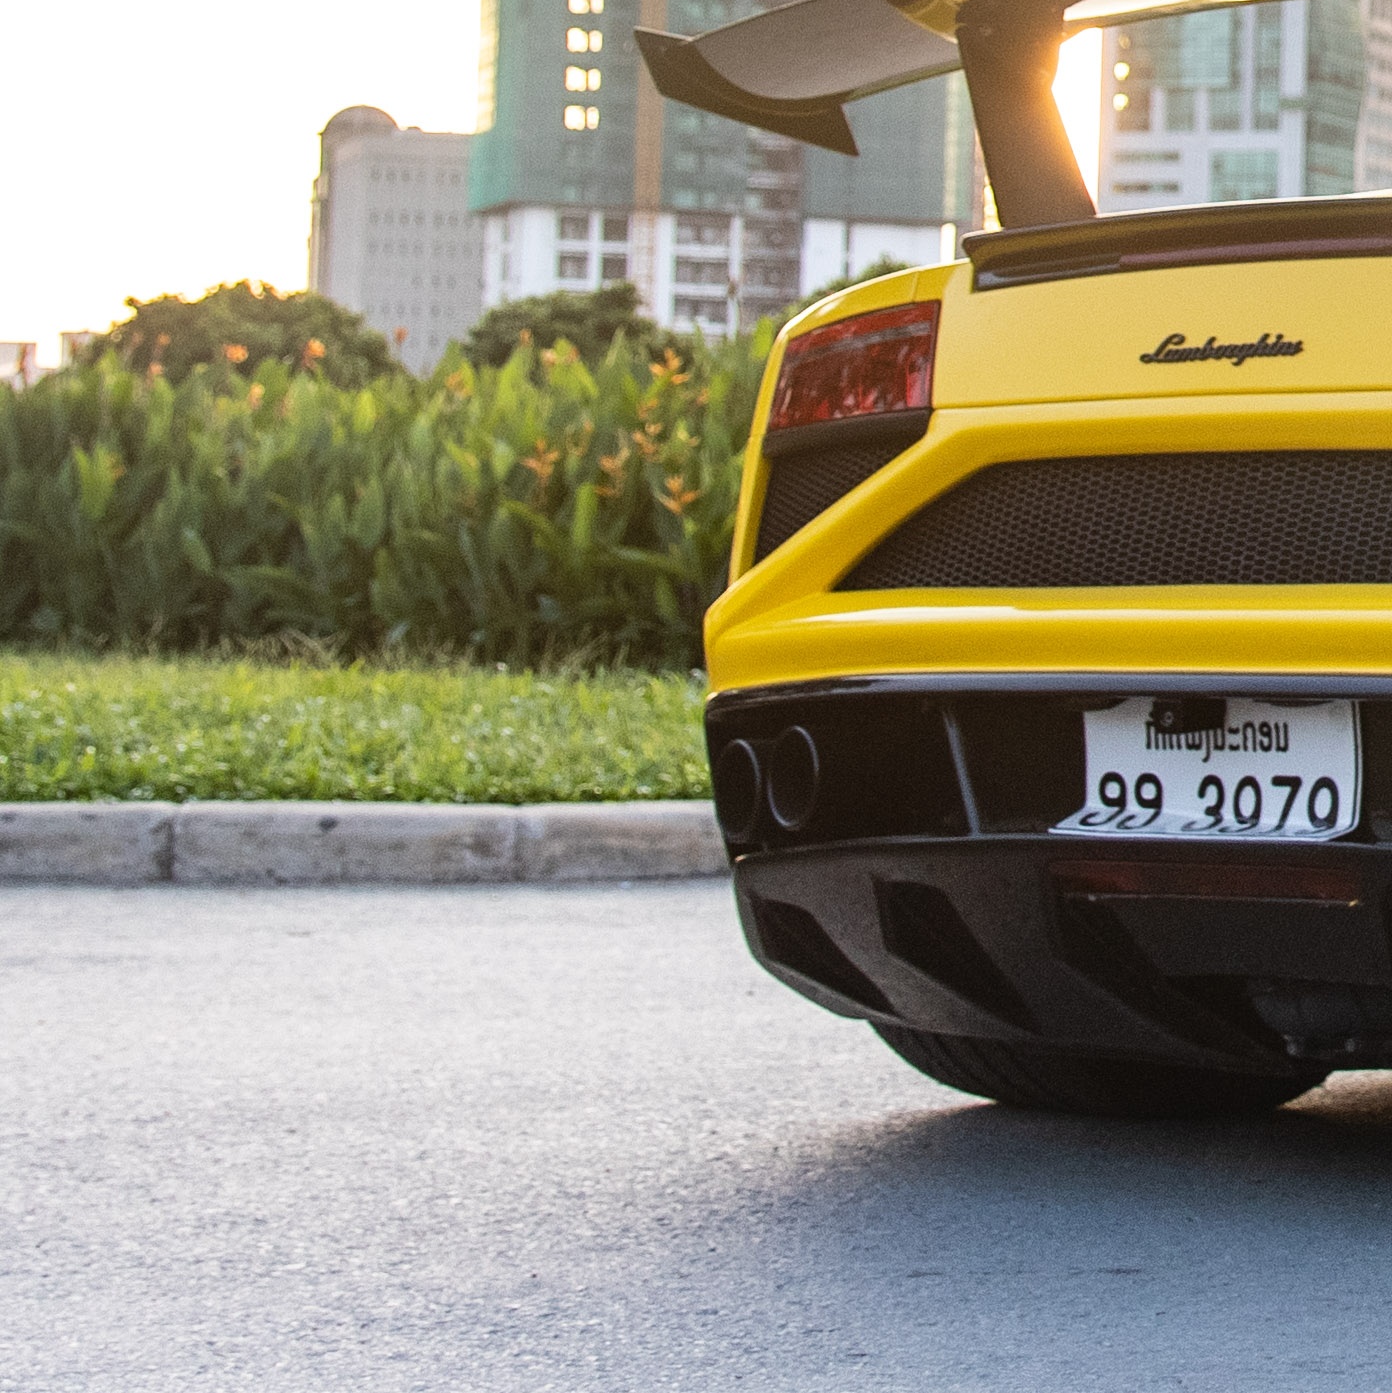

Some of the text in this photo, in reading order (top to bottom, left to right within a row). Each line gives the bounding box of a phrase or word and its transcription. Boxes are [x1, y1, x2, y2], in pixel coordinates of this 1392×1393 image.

[1139, 333, 1304, 367] Lamborghini
[1079, 771, 1341, 832] 99 3070
